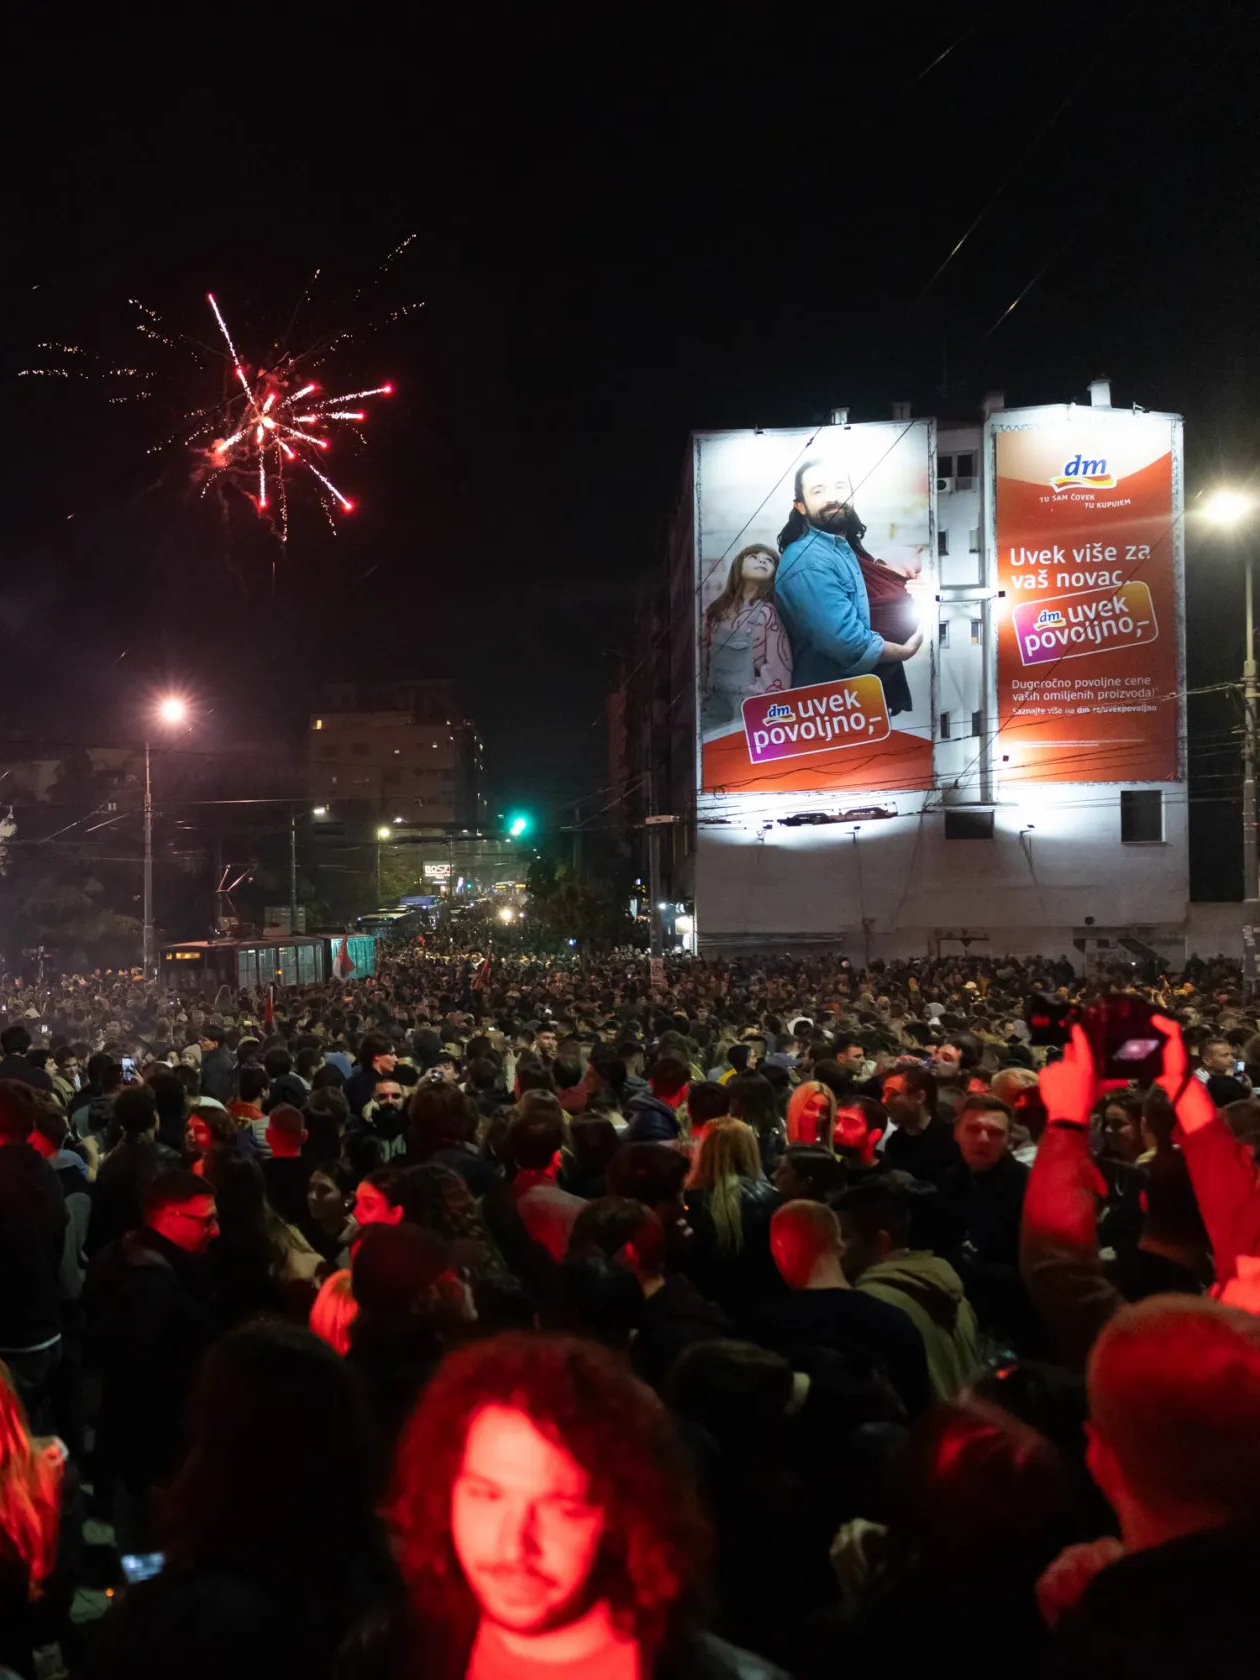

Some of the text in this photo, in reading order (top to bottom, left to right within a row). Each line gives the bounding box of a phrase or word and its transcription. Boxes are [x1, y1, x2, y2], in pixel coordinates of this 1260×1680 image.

[1064, 454, 1107, 477] dm
[1052, 494, 1068, 502] SAM
[1070, 493, 1095, 501] ČOVEK
[1097, 499, 1131, 509] KUPUJEM
[1010, 542, 1151, 567] Uvek više za
[1011, 569, 1049, 590] vaš
[1039, 595, 1129, 624] dm uvek
[1011, 677, 1151, 690] Dugoročno povoljne cene
[768, 689, 861, 718] dm uvek
[1012, 690, 1040, 701] vaših
[1043, 690, 1094, 702] omiljenih
